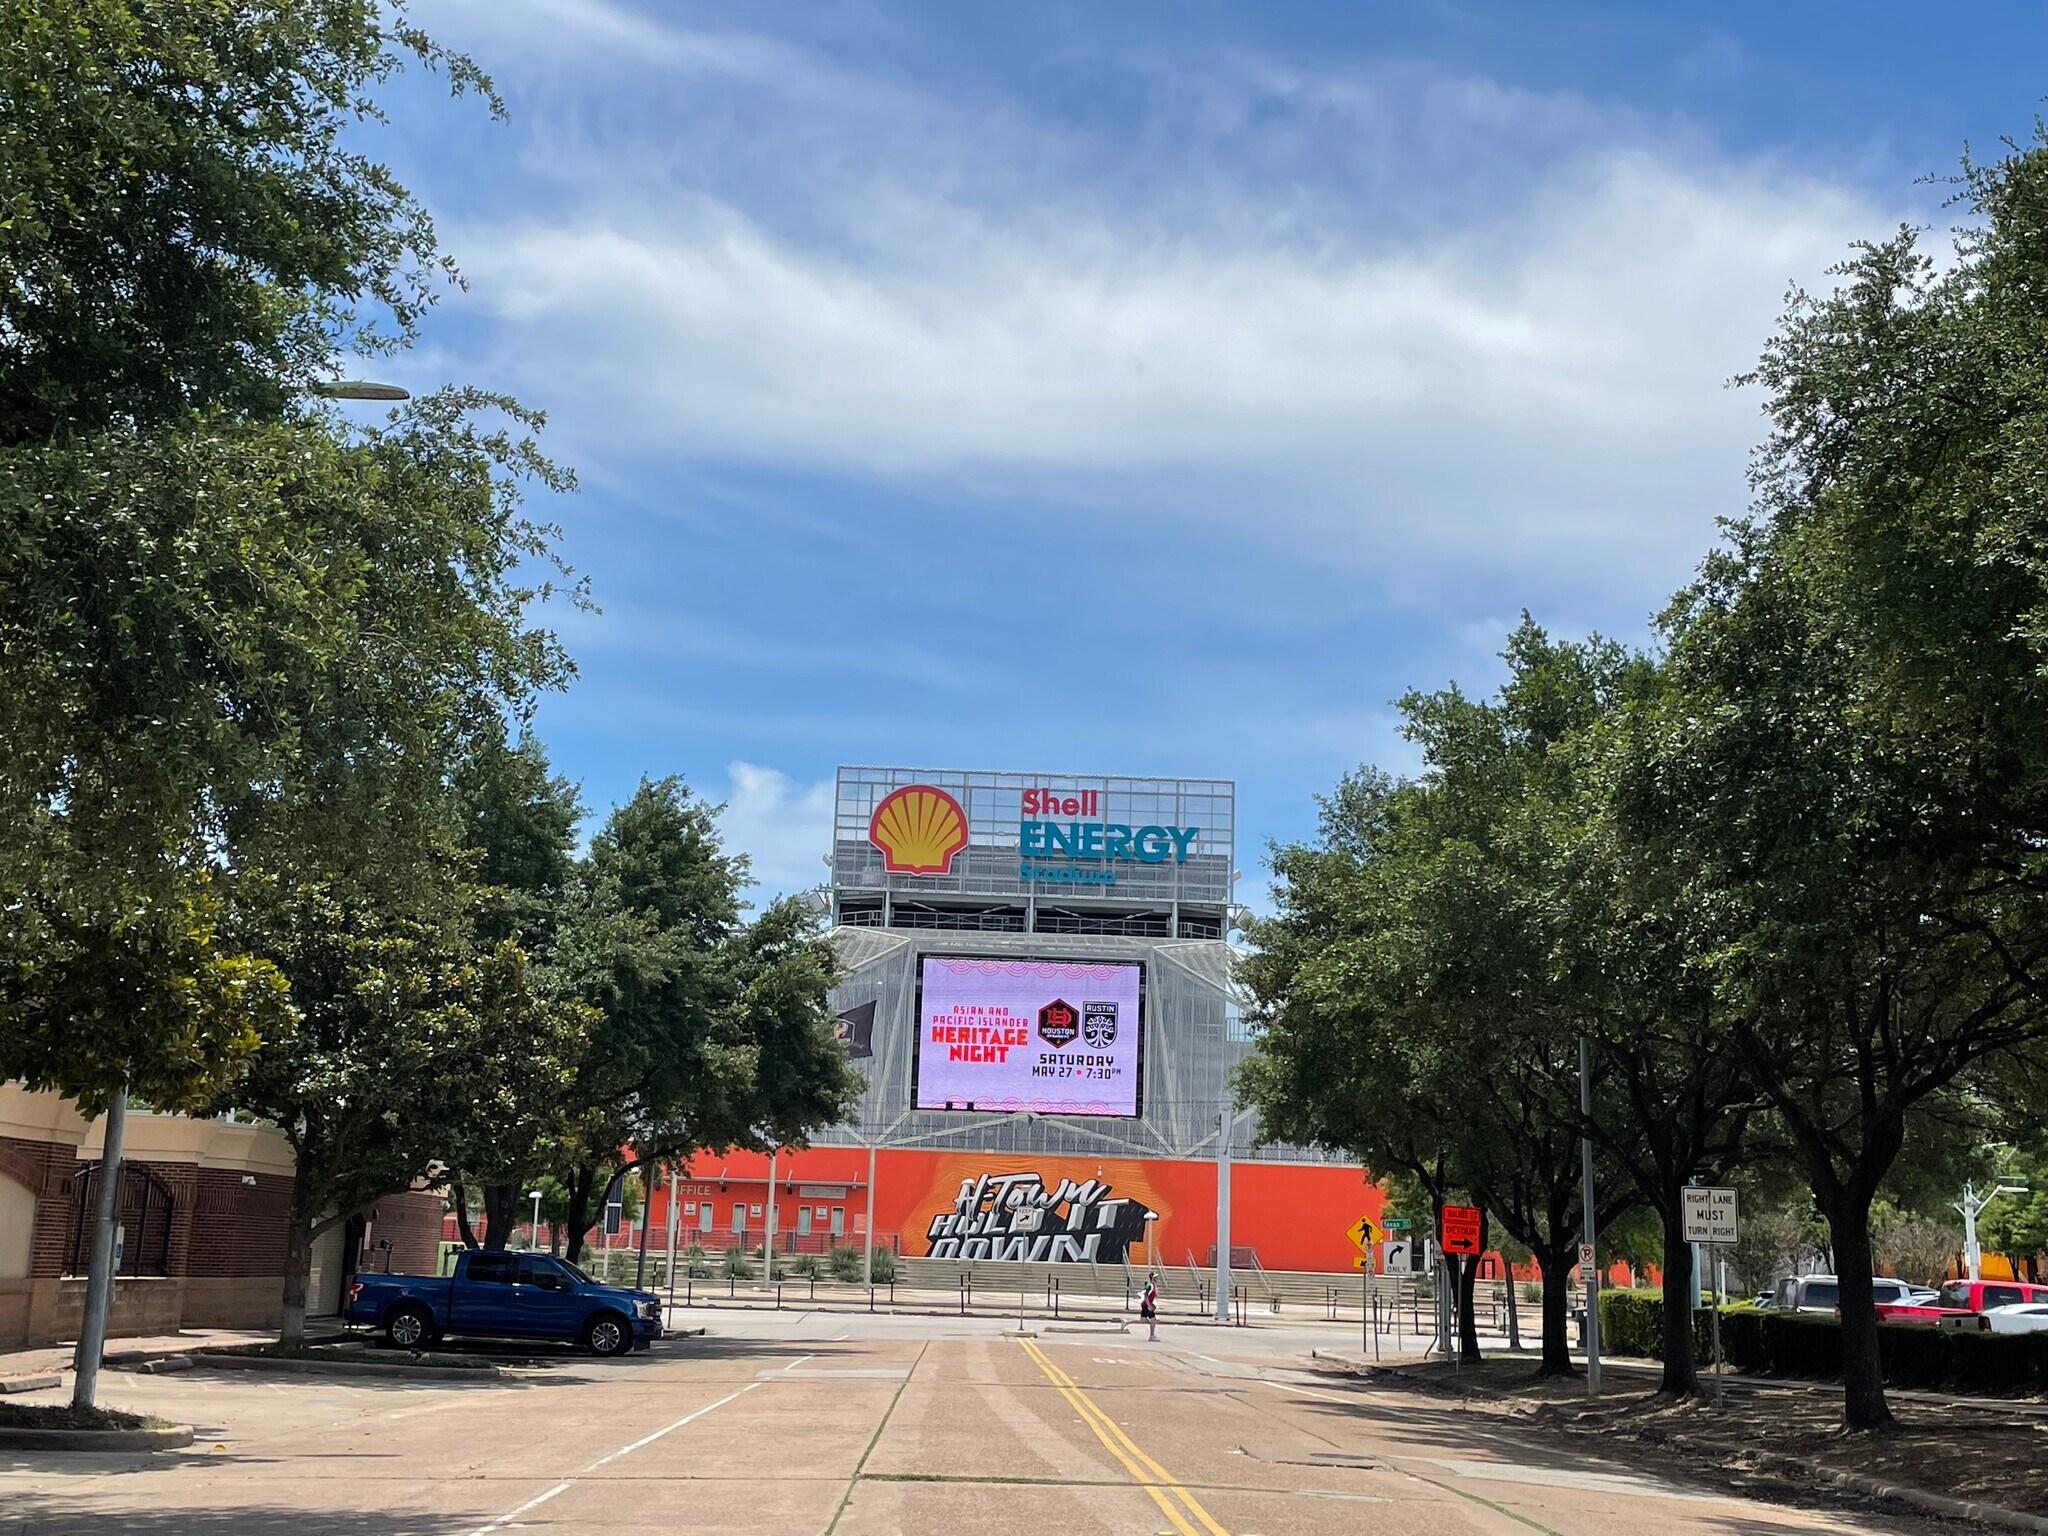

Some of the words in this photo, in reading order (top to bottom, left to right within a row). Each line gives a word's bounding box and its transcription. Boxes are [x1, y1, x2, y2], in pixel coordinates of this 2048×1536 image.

[1022, 788, 1097, 816] Shell
[1020, 821, 1200, 863] ENERGY
[1020, 862, 1116, 885] Stadium
[953, 1005, 984, 1015] ASIAN
[988, 1006, 1009, 1016] AND
[1086, 1004, 1115, 1012] AUSTIN
[932, 1015, 974, 1026] PACIFIC
[978, 1017, 1028, 1027] ISLANDER
[931, 1026, 1028, 1045] HERITAGE
[1041, 1027, 1075, 1036] HOUSTON
[949, 1045, 1009, 1063] NIGHT
[1040, 1053, 1114, 1067] SATURDAY
[1032, 1066, 1055, 1077] MAY
[1058, 1067, 1073, 1078] 27
[1686, 1194, 1709, 1204] RIGHT
[1712, 1195, 1733, 1205] LANE
[1066, 1198, 1130, 1231] IT
[1696, 1209, 1724, 1221] MUST
[1445, 1225, 1477, 1236] DETOUR
[1687, 1225, 1708, 1235] TURN
[1712, 1226, 1735, 1236] RIGHT
[1386, 1265, 1407, 1273] ONLY
